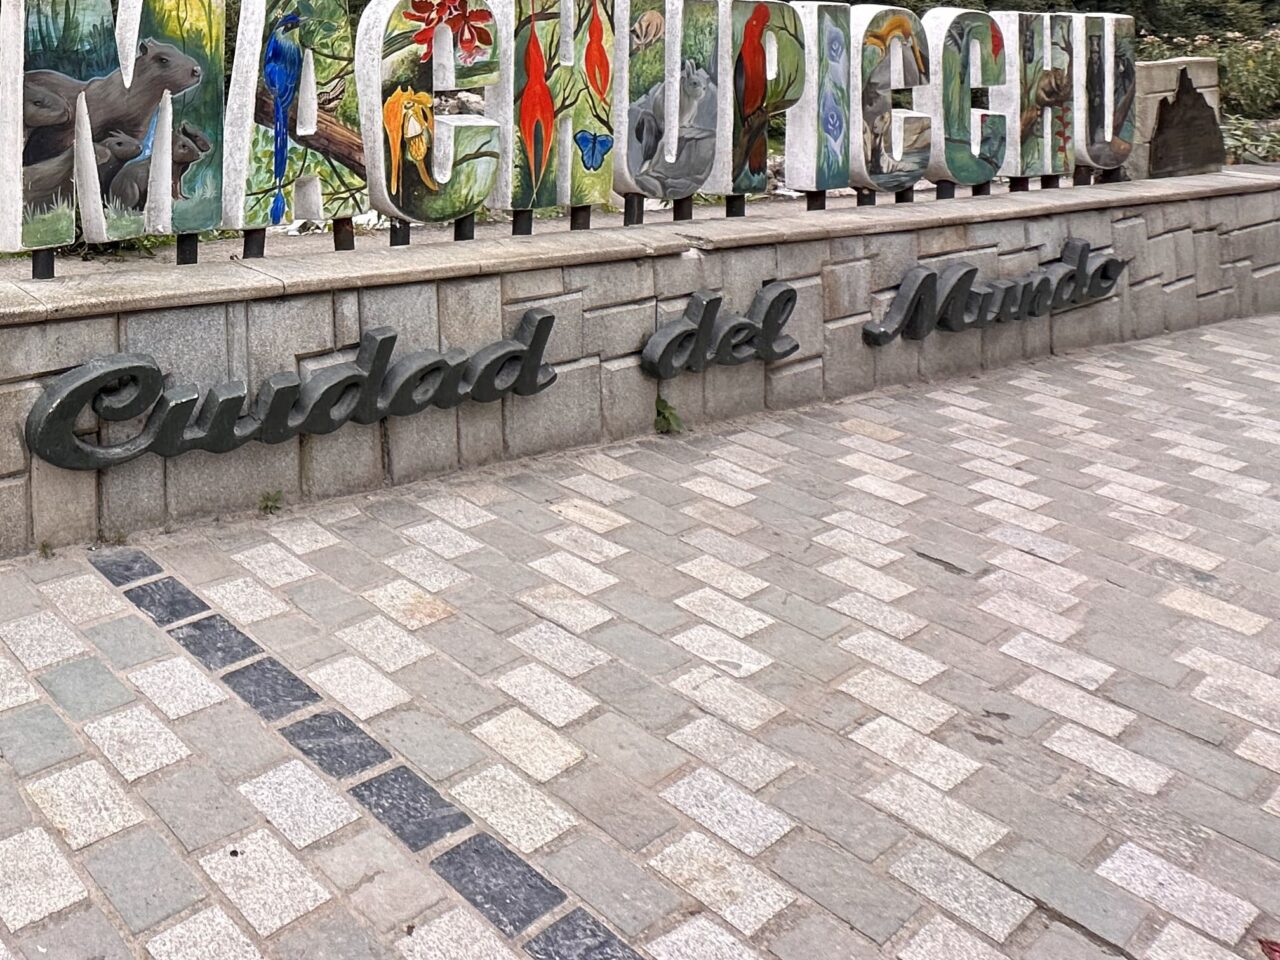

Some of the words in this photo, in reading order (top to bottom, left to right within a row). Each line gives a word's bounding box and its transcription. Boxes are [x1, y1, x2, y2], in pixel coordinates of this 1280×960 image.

[25, 307, 558, 470] Ciudad
[641, 281, 800, 379] del
[862, 238, 1130, 336] Mundo
